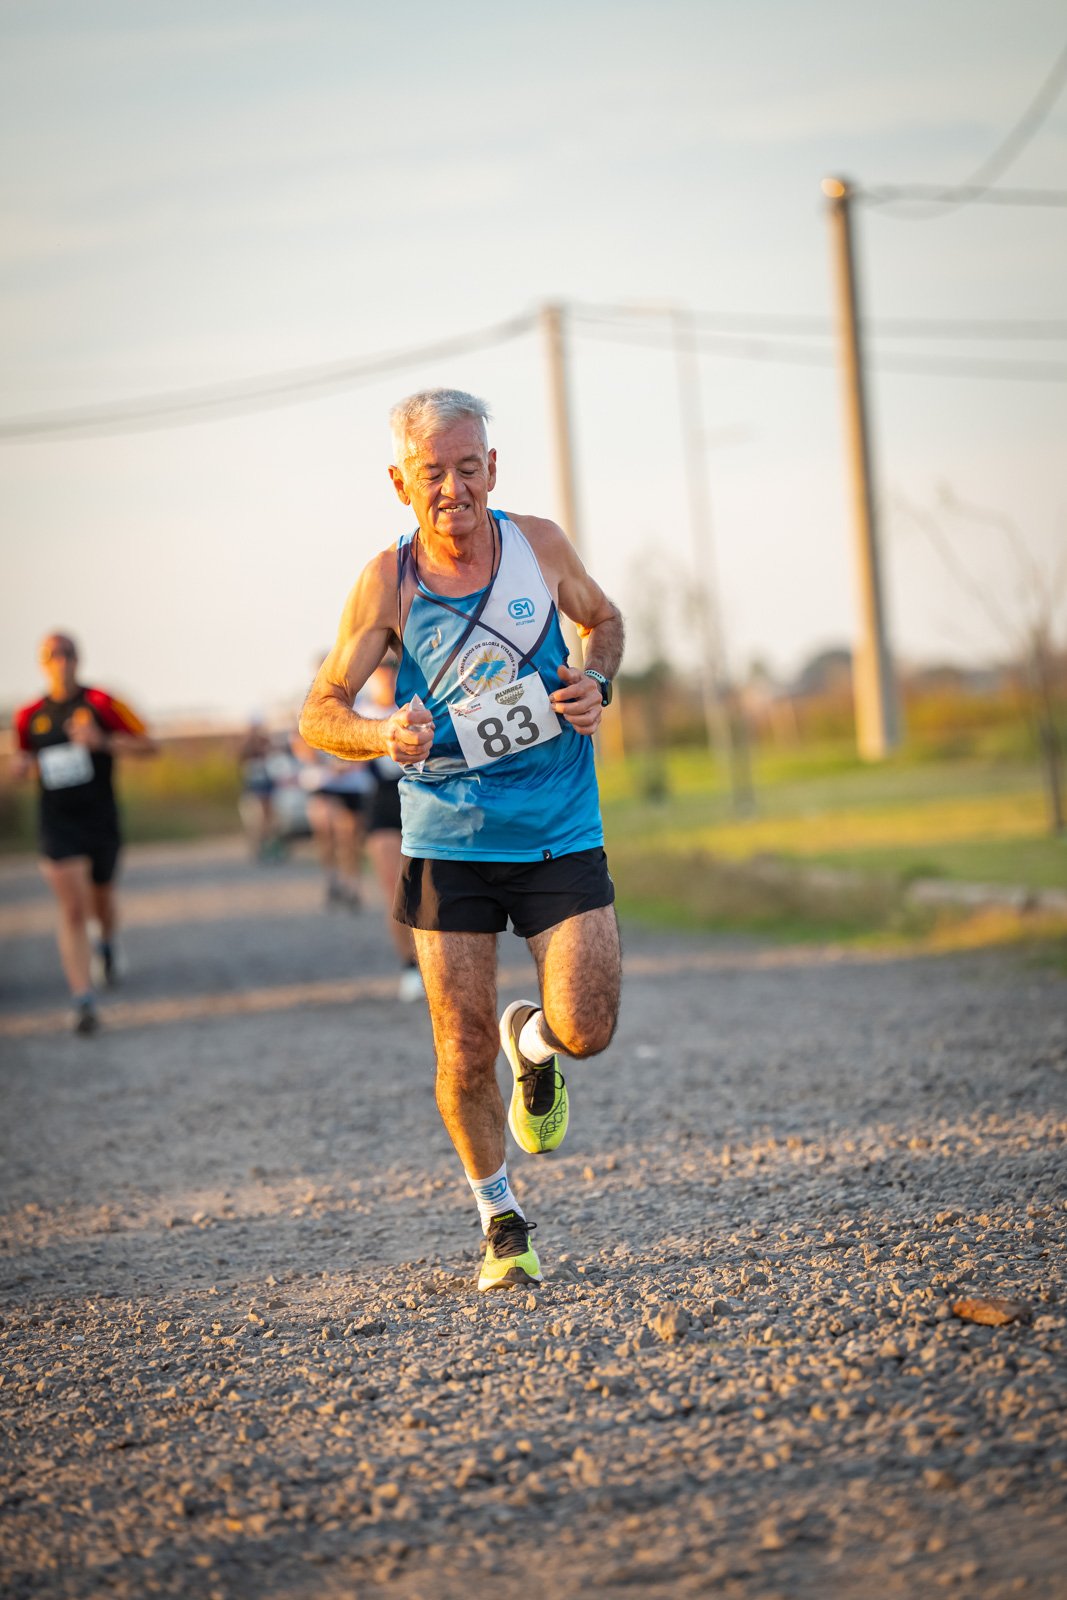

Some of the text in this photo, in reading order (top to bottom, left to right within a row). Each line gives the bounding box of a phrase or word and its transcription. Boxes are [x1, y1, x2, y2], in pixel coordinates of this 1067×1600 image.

[500, 644, 515, 663] VIVAMOS
[494, 683, 523, 700] ALVAREZ
[497, 688, 524, 703] CORRE
[476, 705, 540, 758] 83
